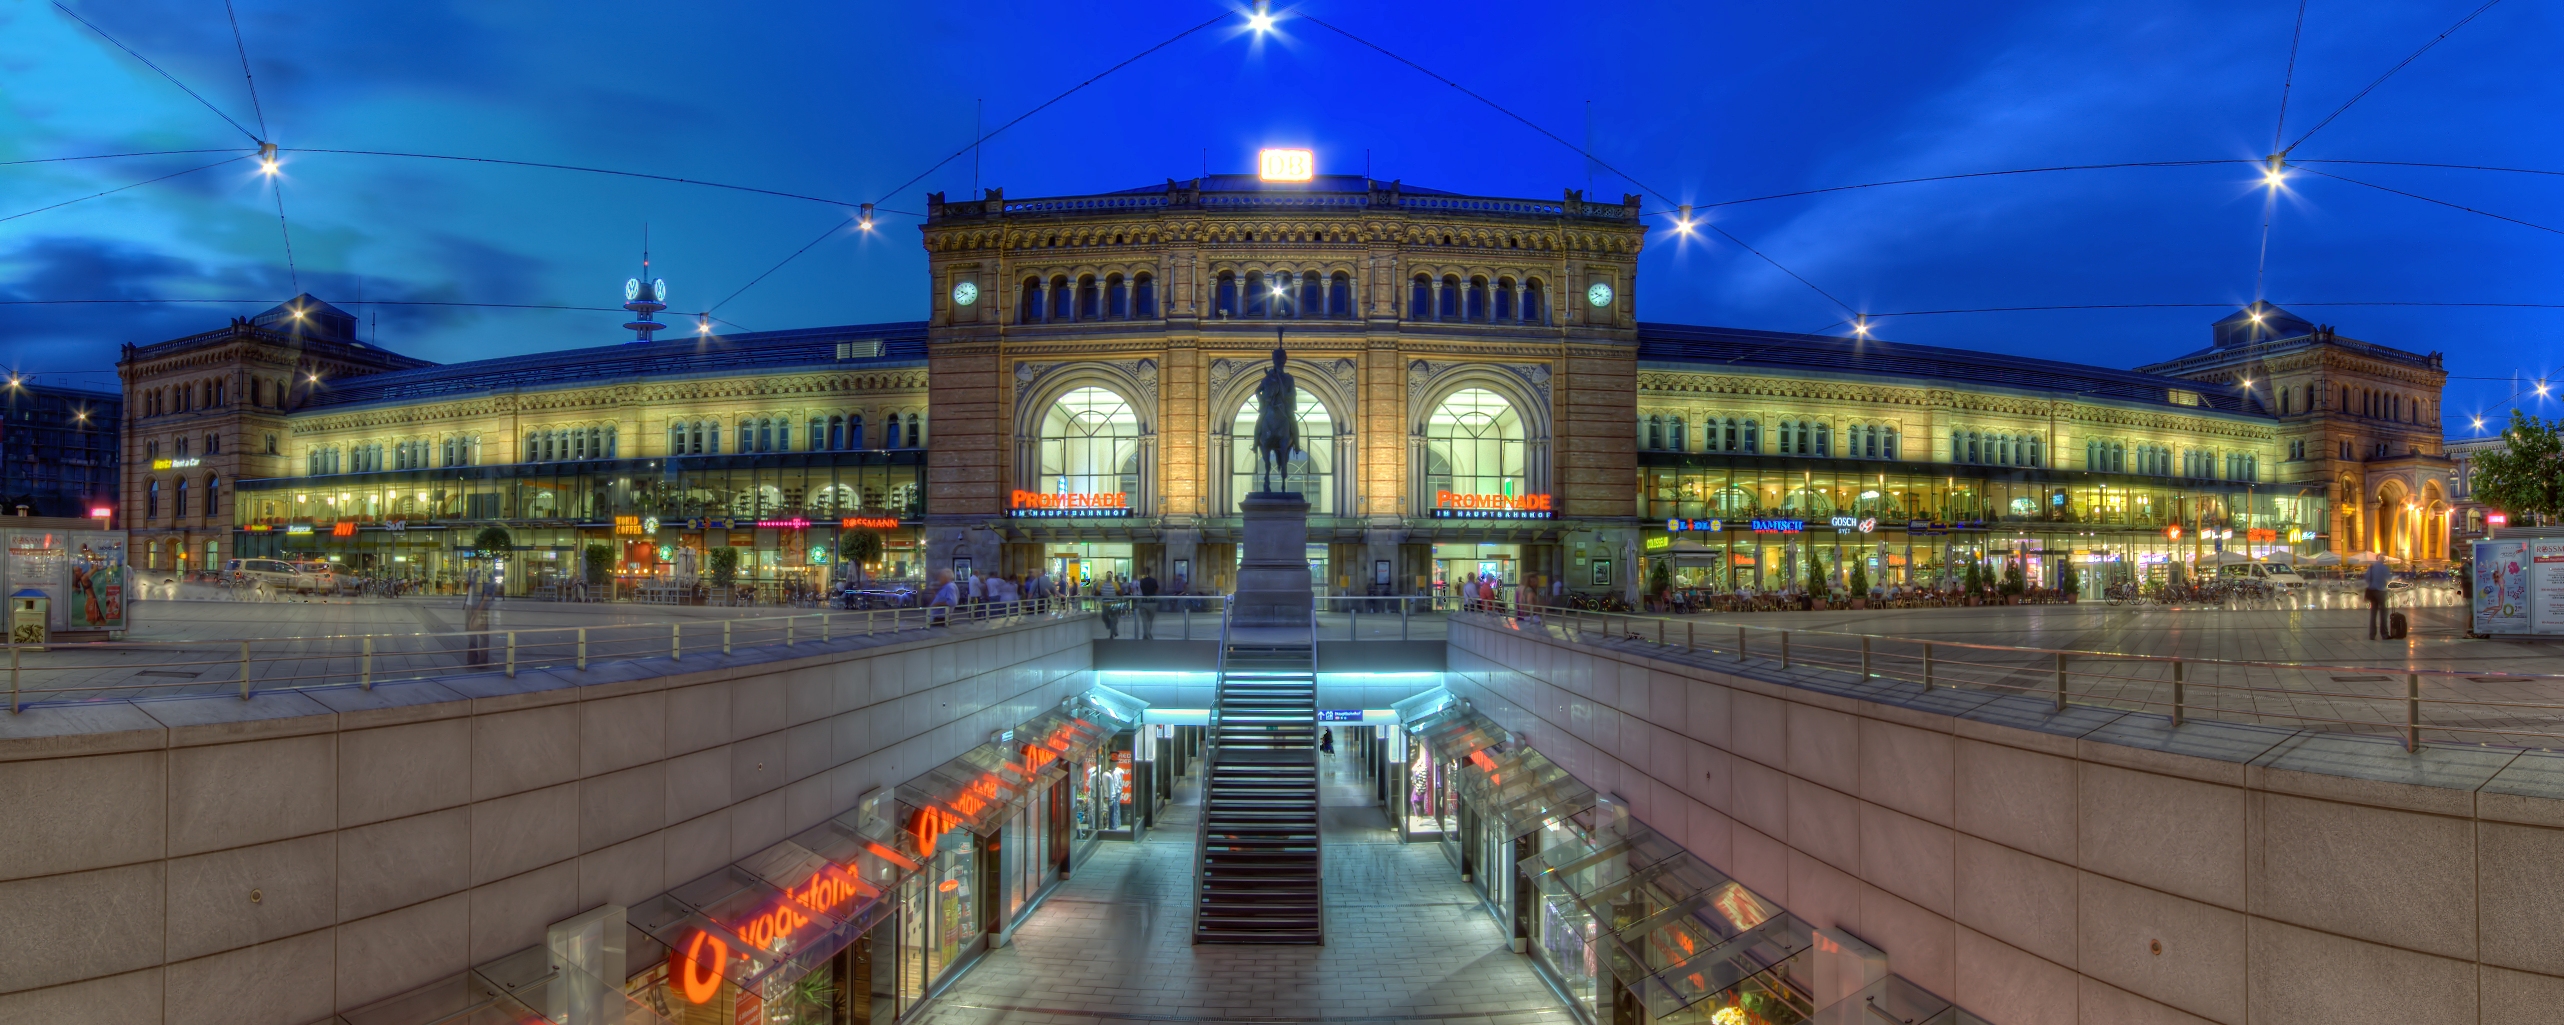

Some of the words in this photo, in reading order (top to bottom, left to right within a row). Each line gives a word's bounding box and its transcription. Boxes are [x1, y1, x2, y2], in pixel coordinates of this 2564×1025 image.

[1268, 155, 1304, 175] DB
[153, 459, 172, 469] Hertz
[172, 459, 185, 468] Rent
[190, 458, 199, 466] Car
[1011, 490, 1127, 508] PROMENADE
[1436, 490, 1551, 510] PROMENADE
[1011, 509, 1024, 517] IM
[1032, 509, 1127, 517] HAUPTBAHNHOF
[1457, 510, 1552, 519] HAUPTBAHNHOF
[615, 516, 638, 525] WORLD
[843, 518, 898, 528] ROSSMANN
[1752, 520, 1803, 530] DAMISCH
[1831, 517, 1857, 527] GOSCH
[334, 522, 358, 536] AVIS
[616, 525, 642, 534] COFFEE
